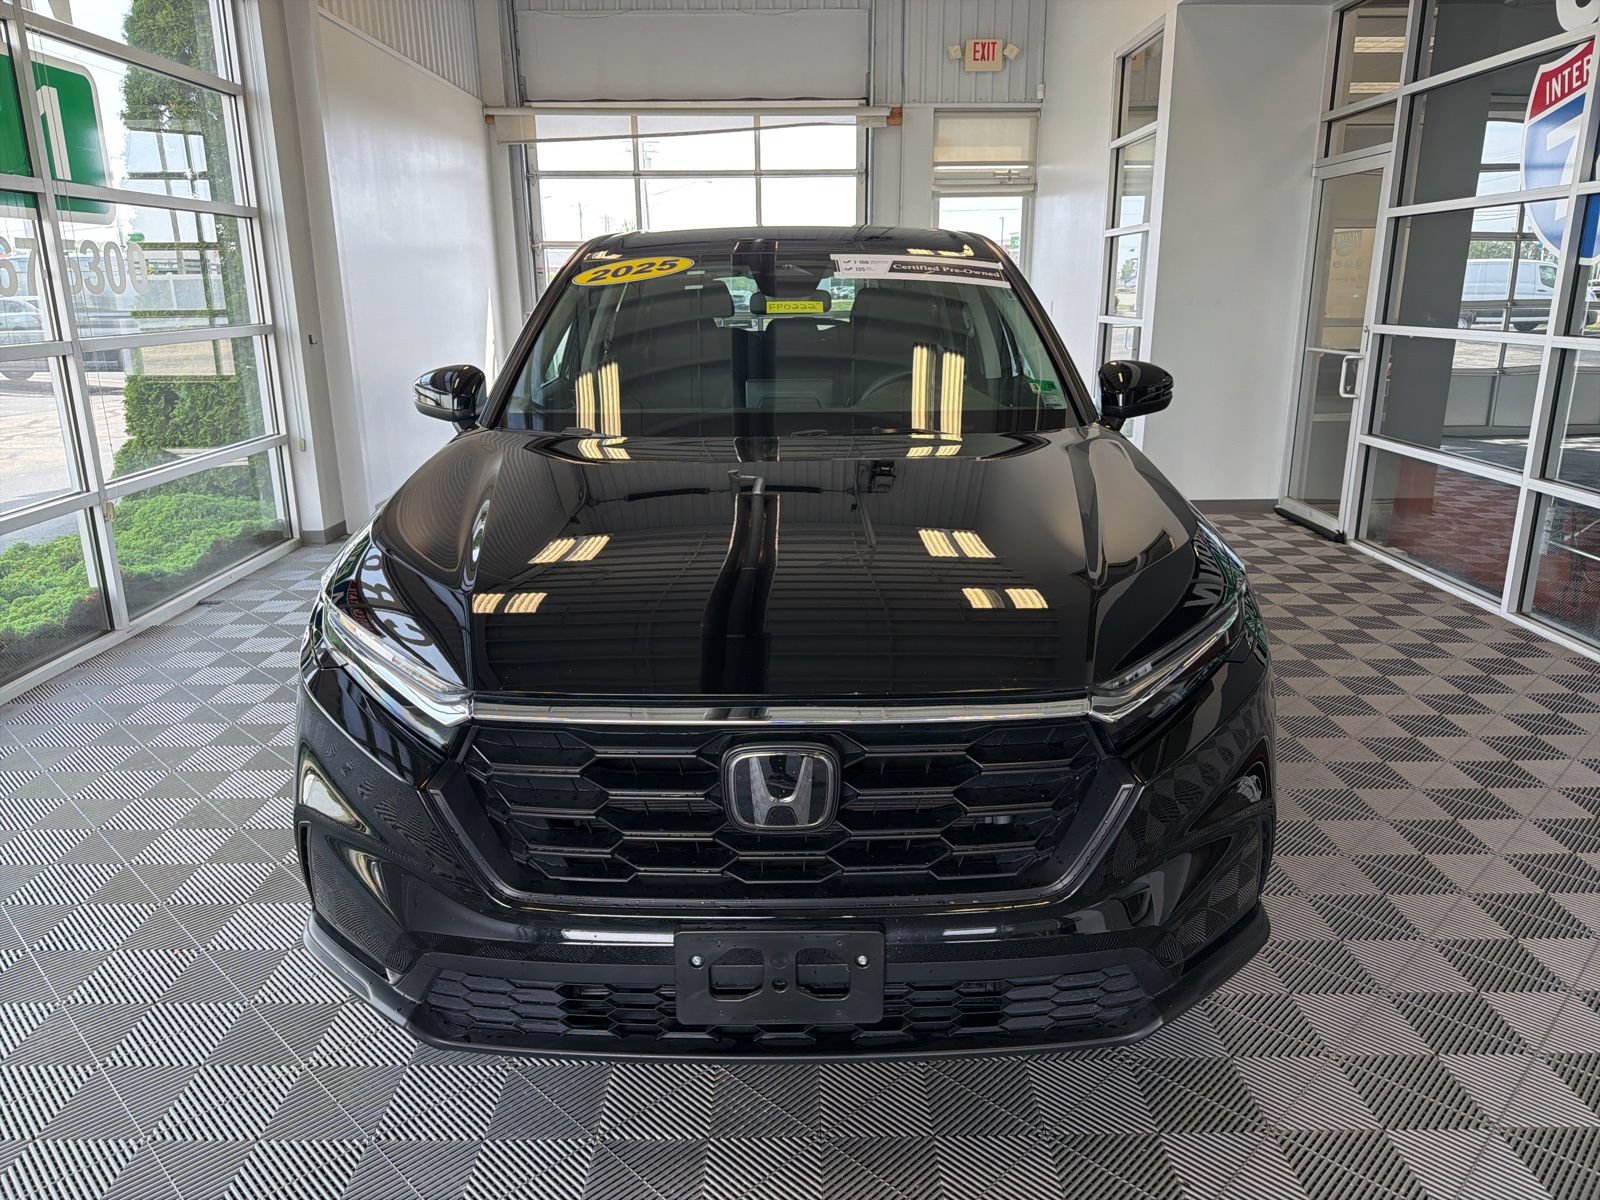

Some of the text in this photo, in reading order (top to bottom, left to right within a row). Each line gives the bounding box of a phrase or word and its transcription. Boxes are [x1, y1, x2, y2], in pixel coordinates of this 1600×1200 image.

[973, 41, 997, 62] EXIT
[587, 259, 681, 282] 2025
[892, 263, 1001, 278] Certified Pre-Owned
